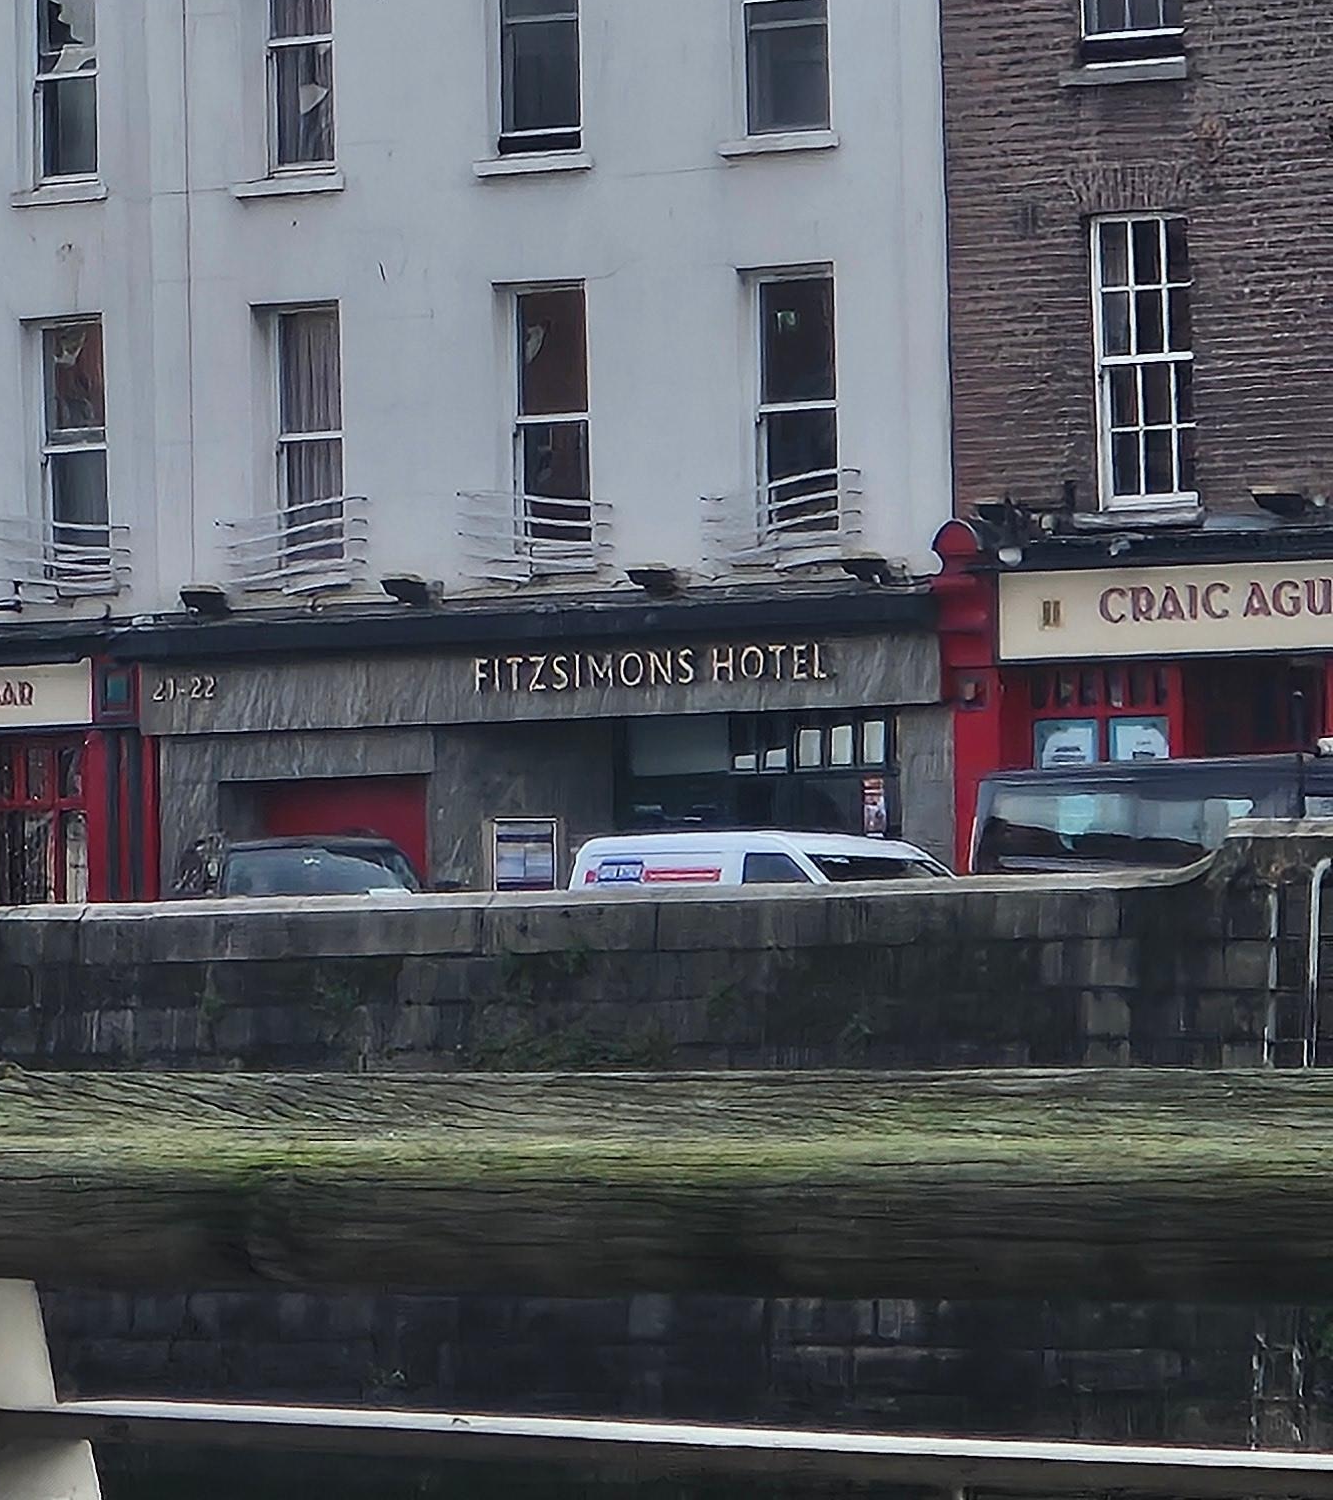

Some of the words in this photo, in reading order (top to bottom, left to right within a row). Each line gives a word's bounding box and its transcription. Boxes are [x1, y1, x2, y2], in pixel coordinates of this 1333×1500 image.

[1098, 581, 1230, 624] CRAIC
[473, 649, 694, 693] FITZSIMONS
[712, 644, 827, 682] HOTEL
